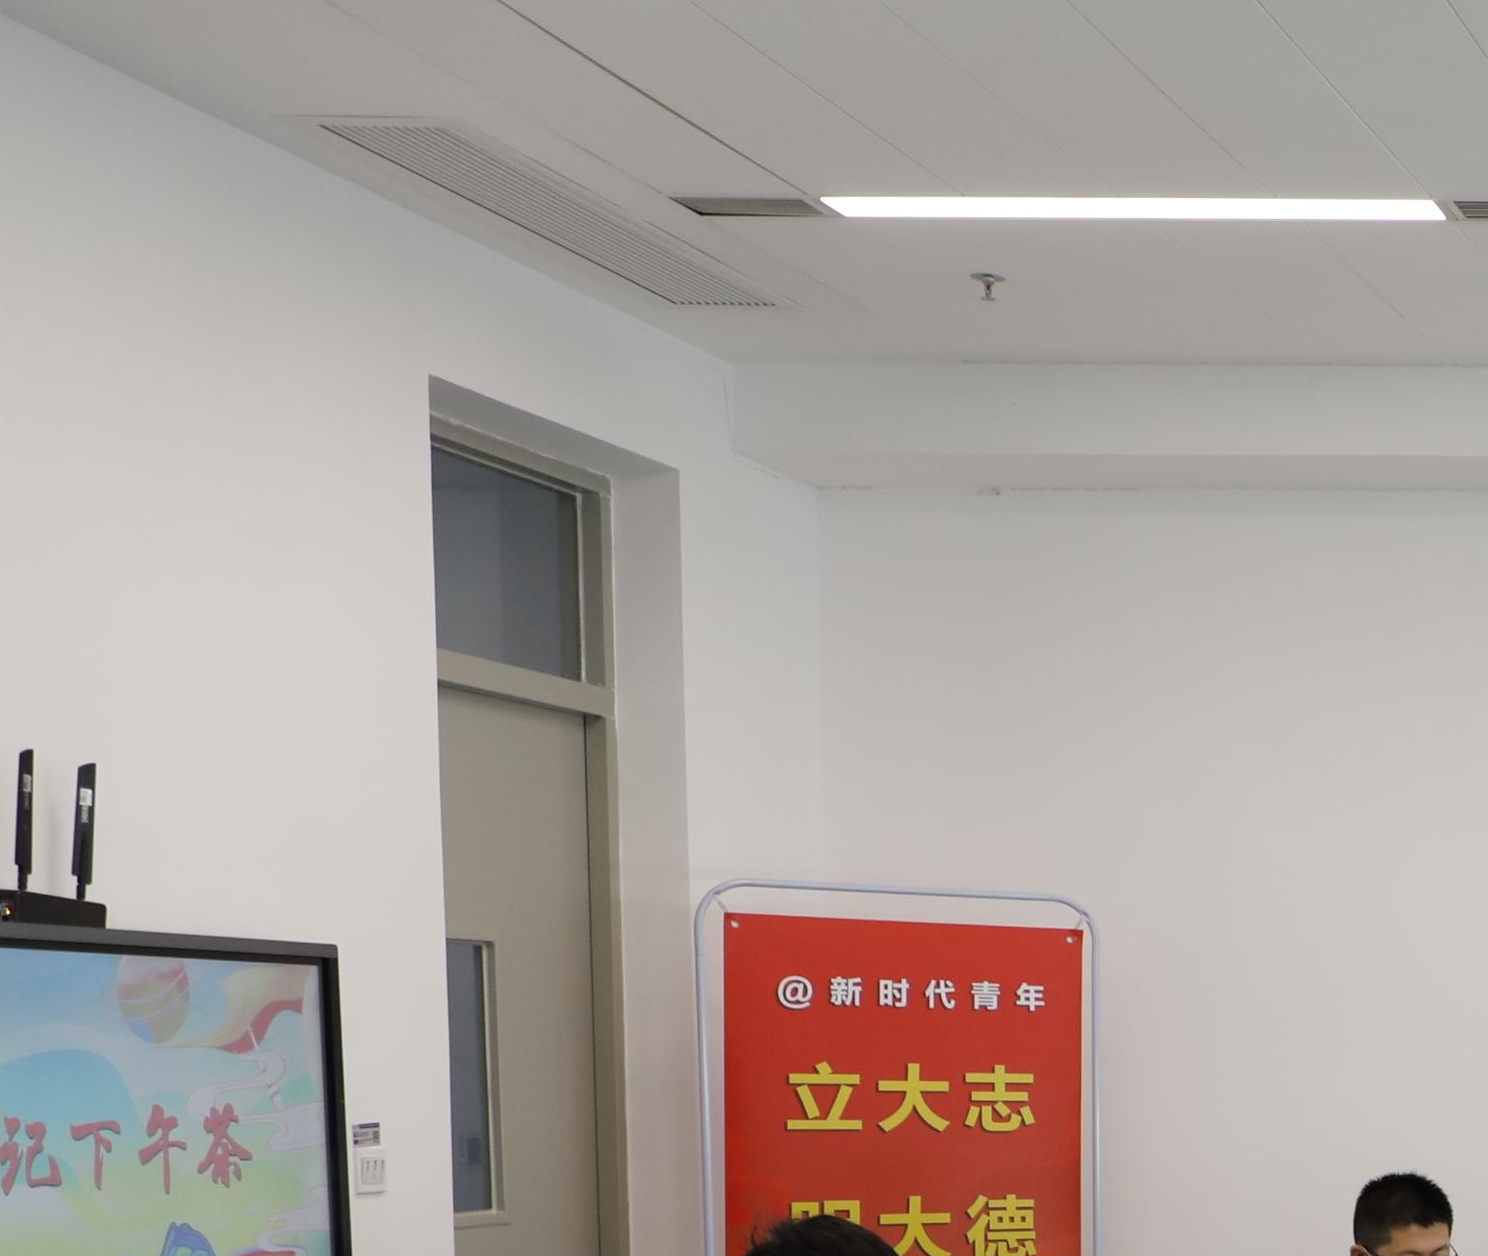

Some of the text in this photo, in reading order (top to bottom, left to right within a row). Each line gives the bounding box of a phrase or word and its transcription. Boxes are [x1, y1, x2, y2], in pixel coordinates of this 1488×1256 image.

[777, 975, 1046, 1012] @新时代青年
[786, 1061, 1036, 1133] 立大志
